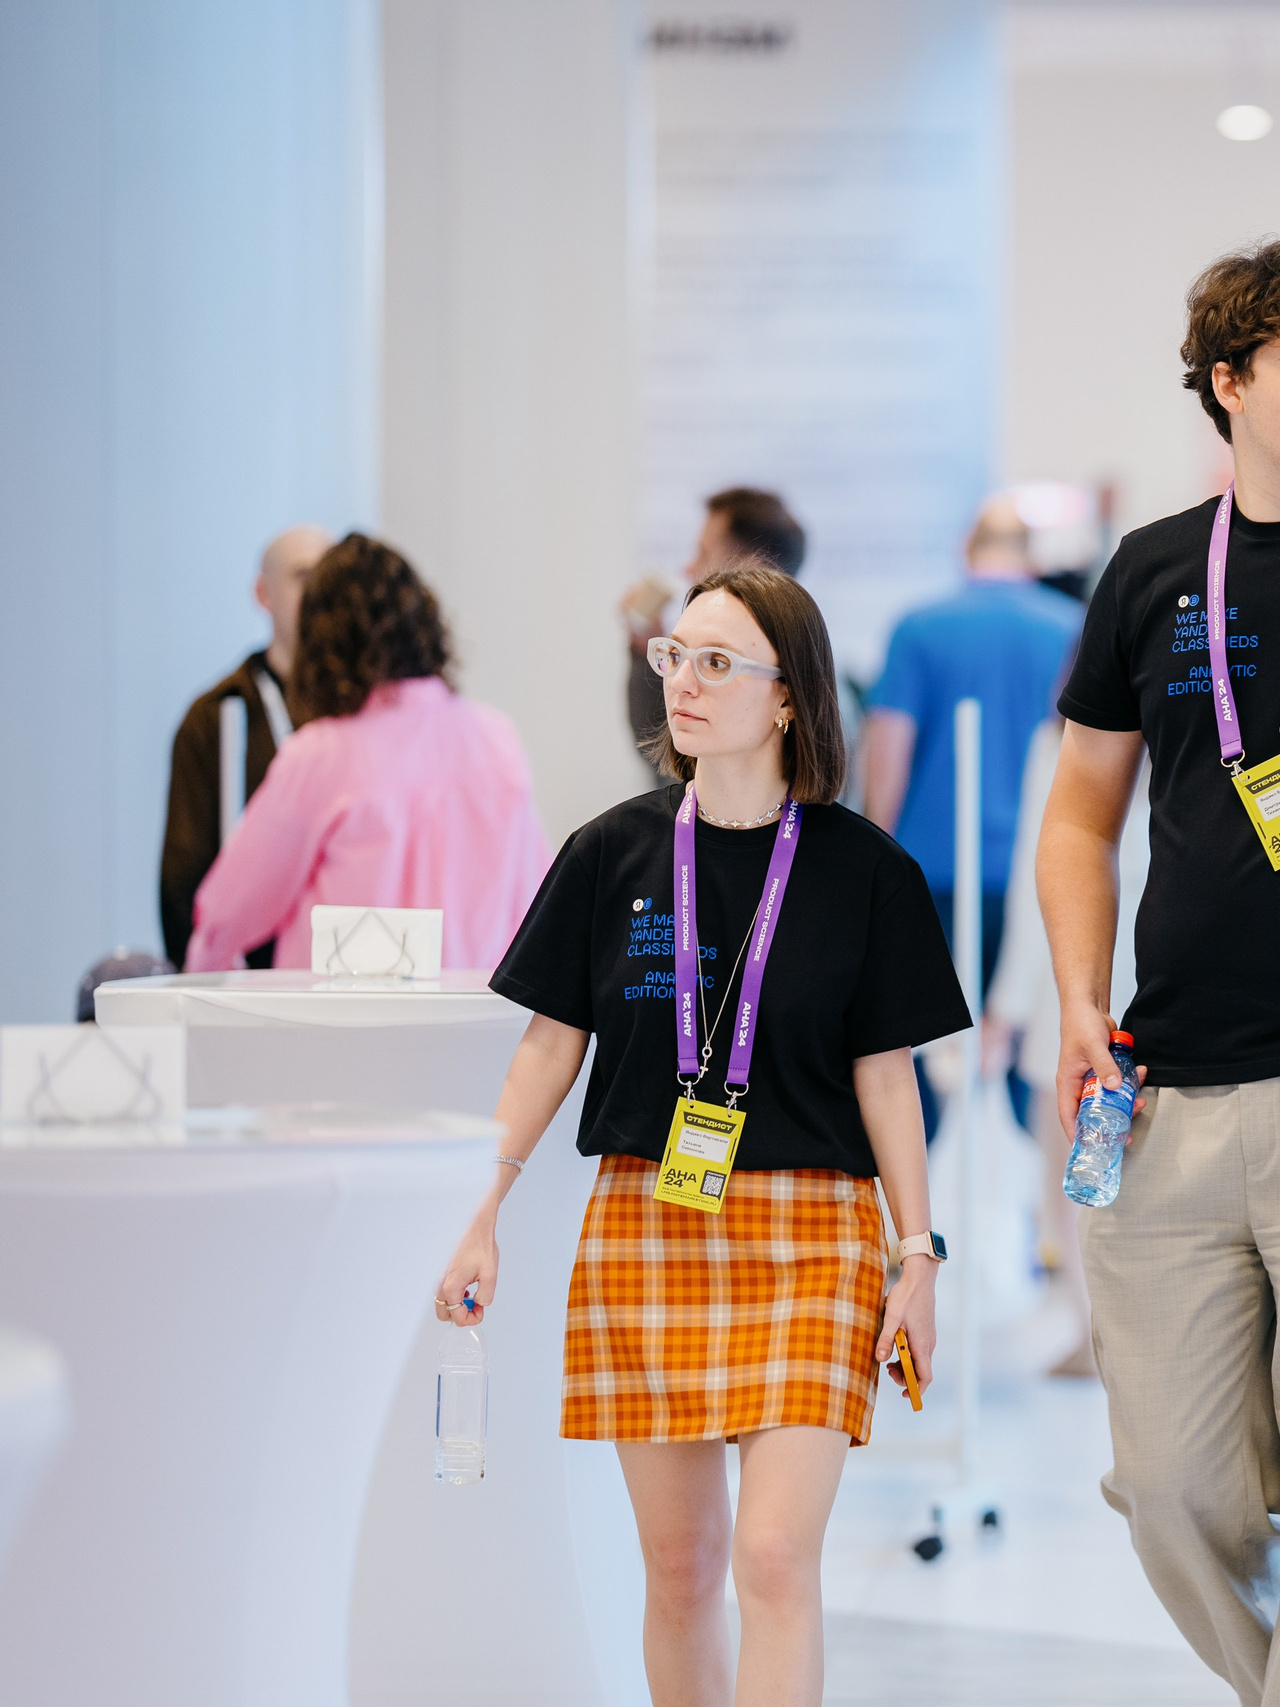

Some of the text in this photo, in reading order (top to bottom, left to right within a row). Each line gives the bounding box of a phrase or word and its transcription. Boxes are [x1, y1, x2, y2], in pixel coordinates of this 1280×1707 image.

[1176, 612, 1198, 625] WE
[1172, 636, 1258, 652] CLASSIEDS
[1168, 680, 1212, 696] EDITIO
[1217, 678, 1232, 722] AHA'24
[632, 914, 675, 929] WE MA
[754, 878, 780, 962] PRODUCT SCIENCE
[630, 928, 675, 942] YANDE
[682, 992, 692, 1037] AHA'24
[738, 1002, 752, 1047] AHA'24
[686, 1115, 732, 1131] СТЕНДИСТ
[667, 1168, 697, 1183] AHA
